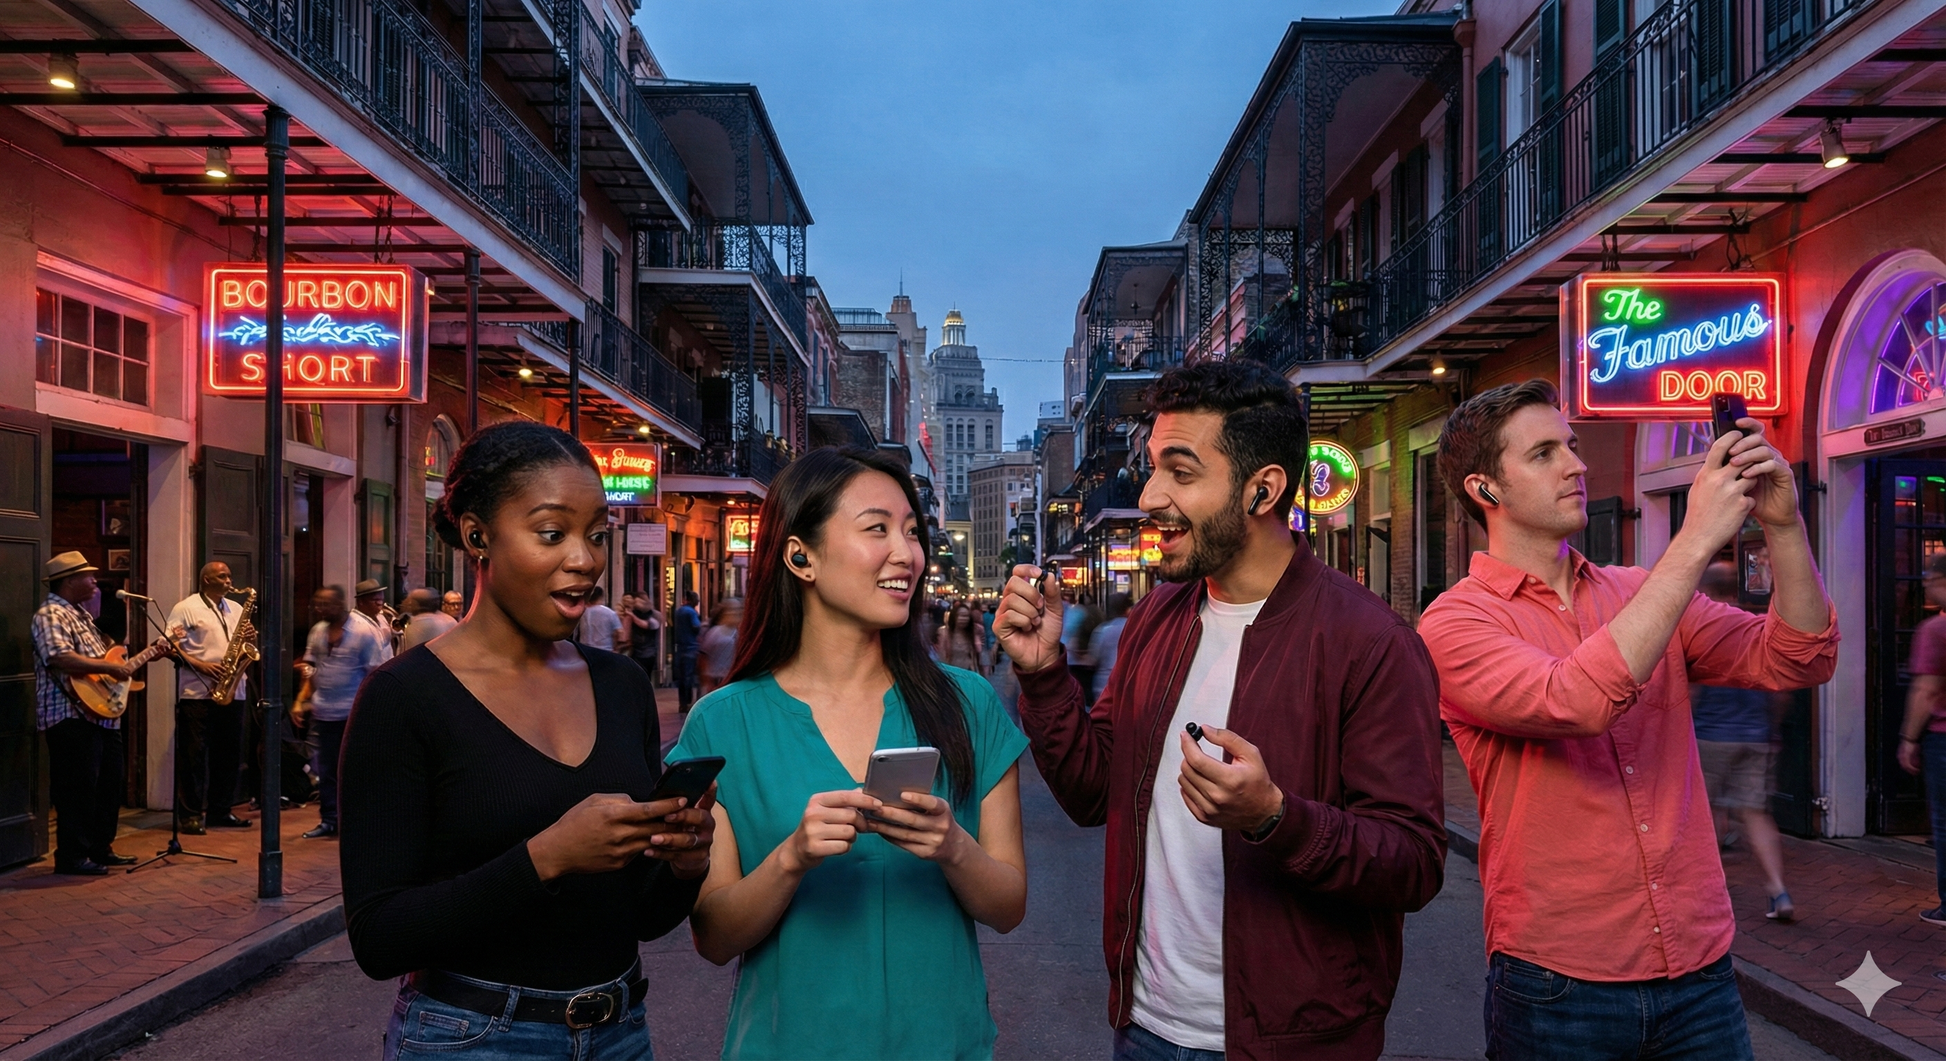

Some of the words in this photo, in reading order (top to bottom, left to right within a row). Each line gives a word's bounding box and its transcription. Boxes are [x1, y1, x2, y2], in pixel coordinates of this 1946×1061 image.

[1604, 288, 1662, 321] The
[1587, 303, 1773, 384] Famous
[1660, 370, 1767, 401] DOOR
